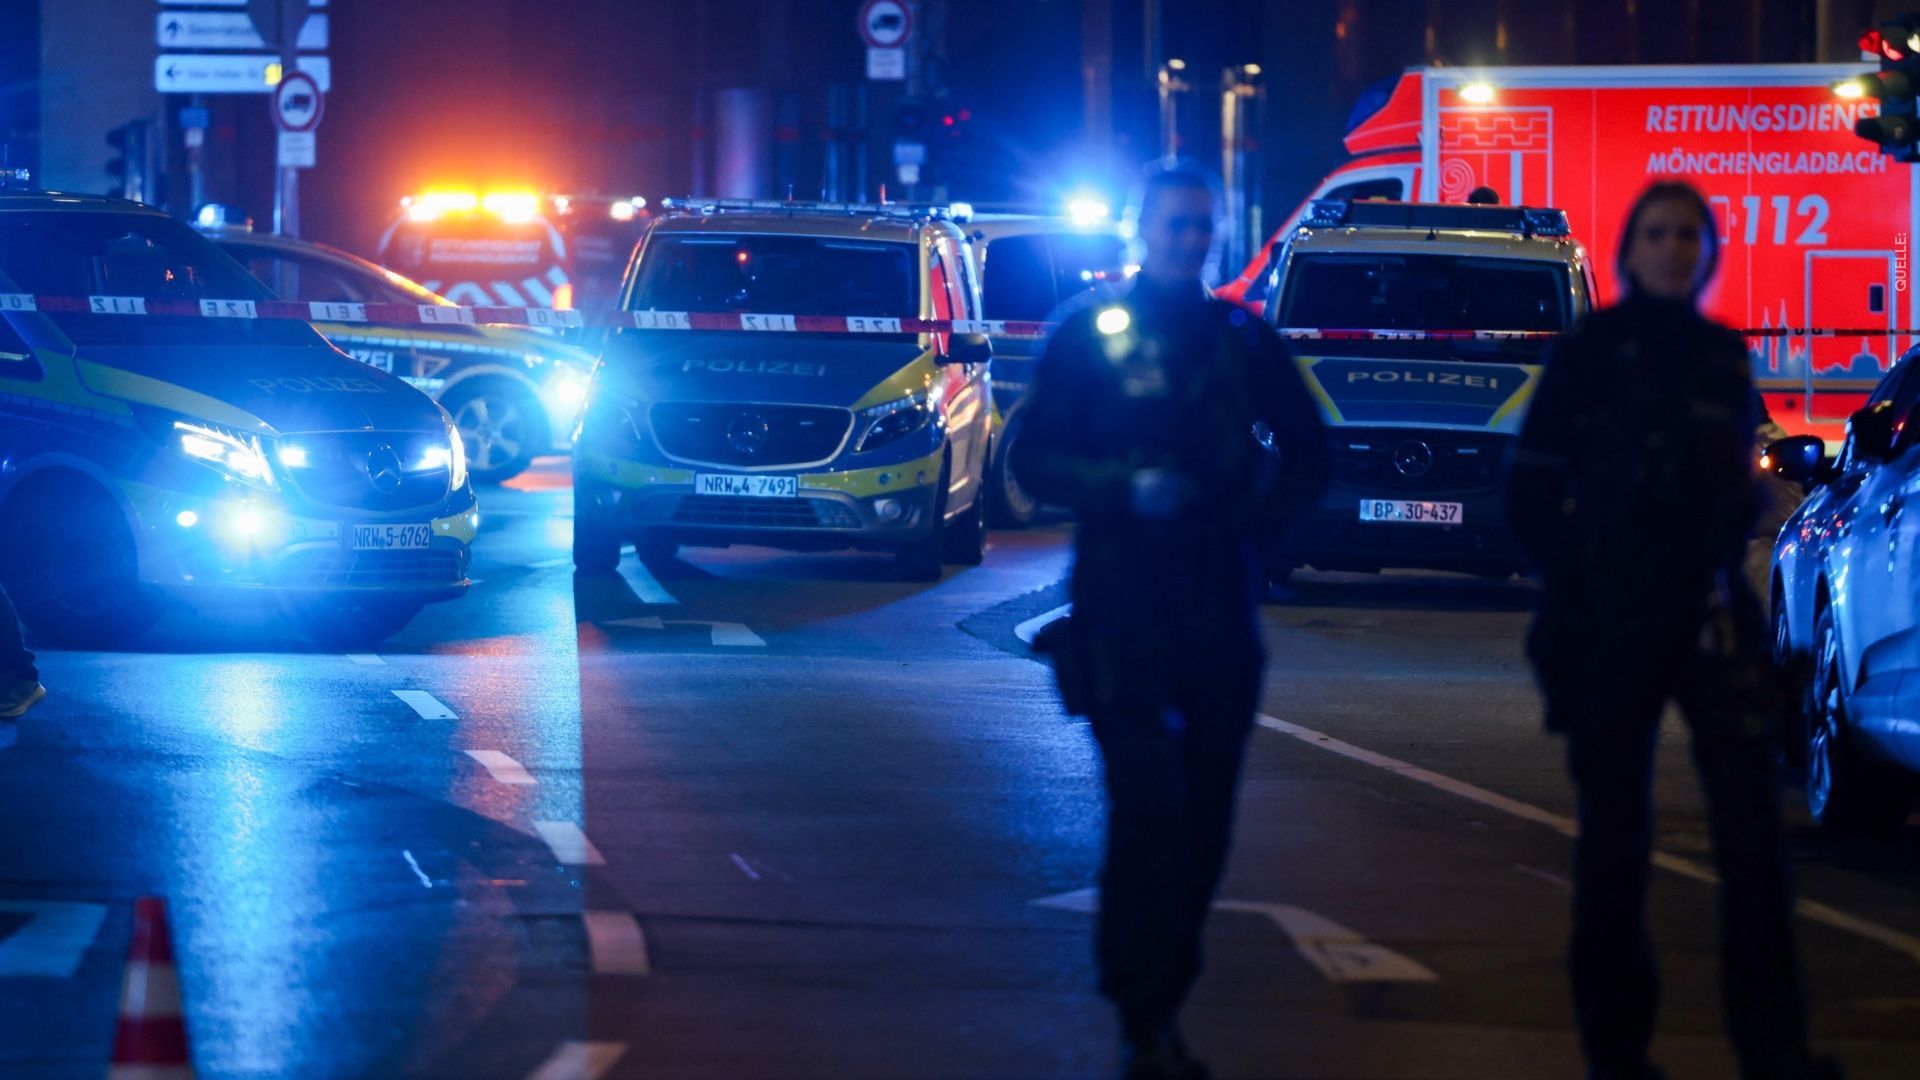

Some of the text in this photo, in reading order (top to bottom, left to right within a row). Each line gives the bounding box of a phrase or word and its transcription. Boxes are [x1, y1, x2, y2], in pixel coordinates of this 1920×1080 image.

[1646, 147, 1886, 174] MÖNCHENGLADBACH
[1742, 194, 1830, 246] 112
[682, 359, 827, 377] POLIZEI
[1347, 371, 1497, 389] POLIZEI
